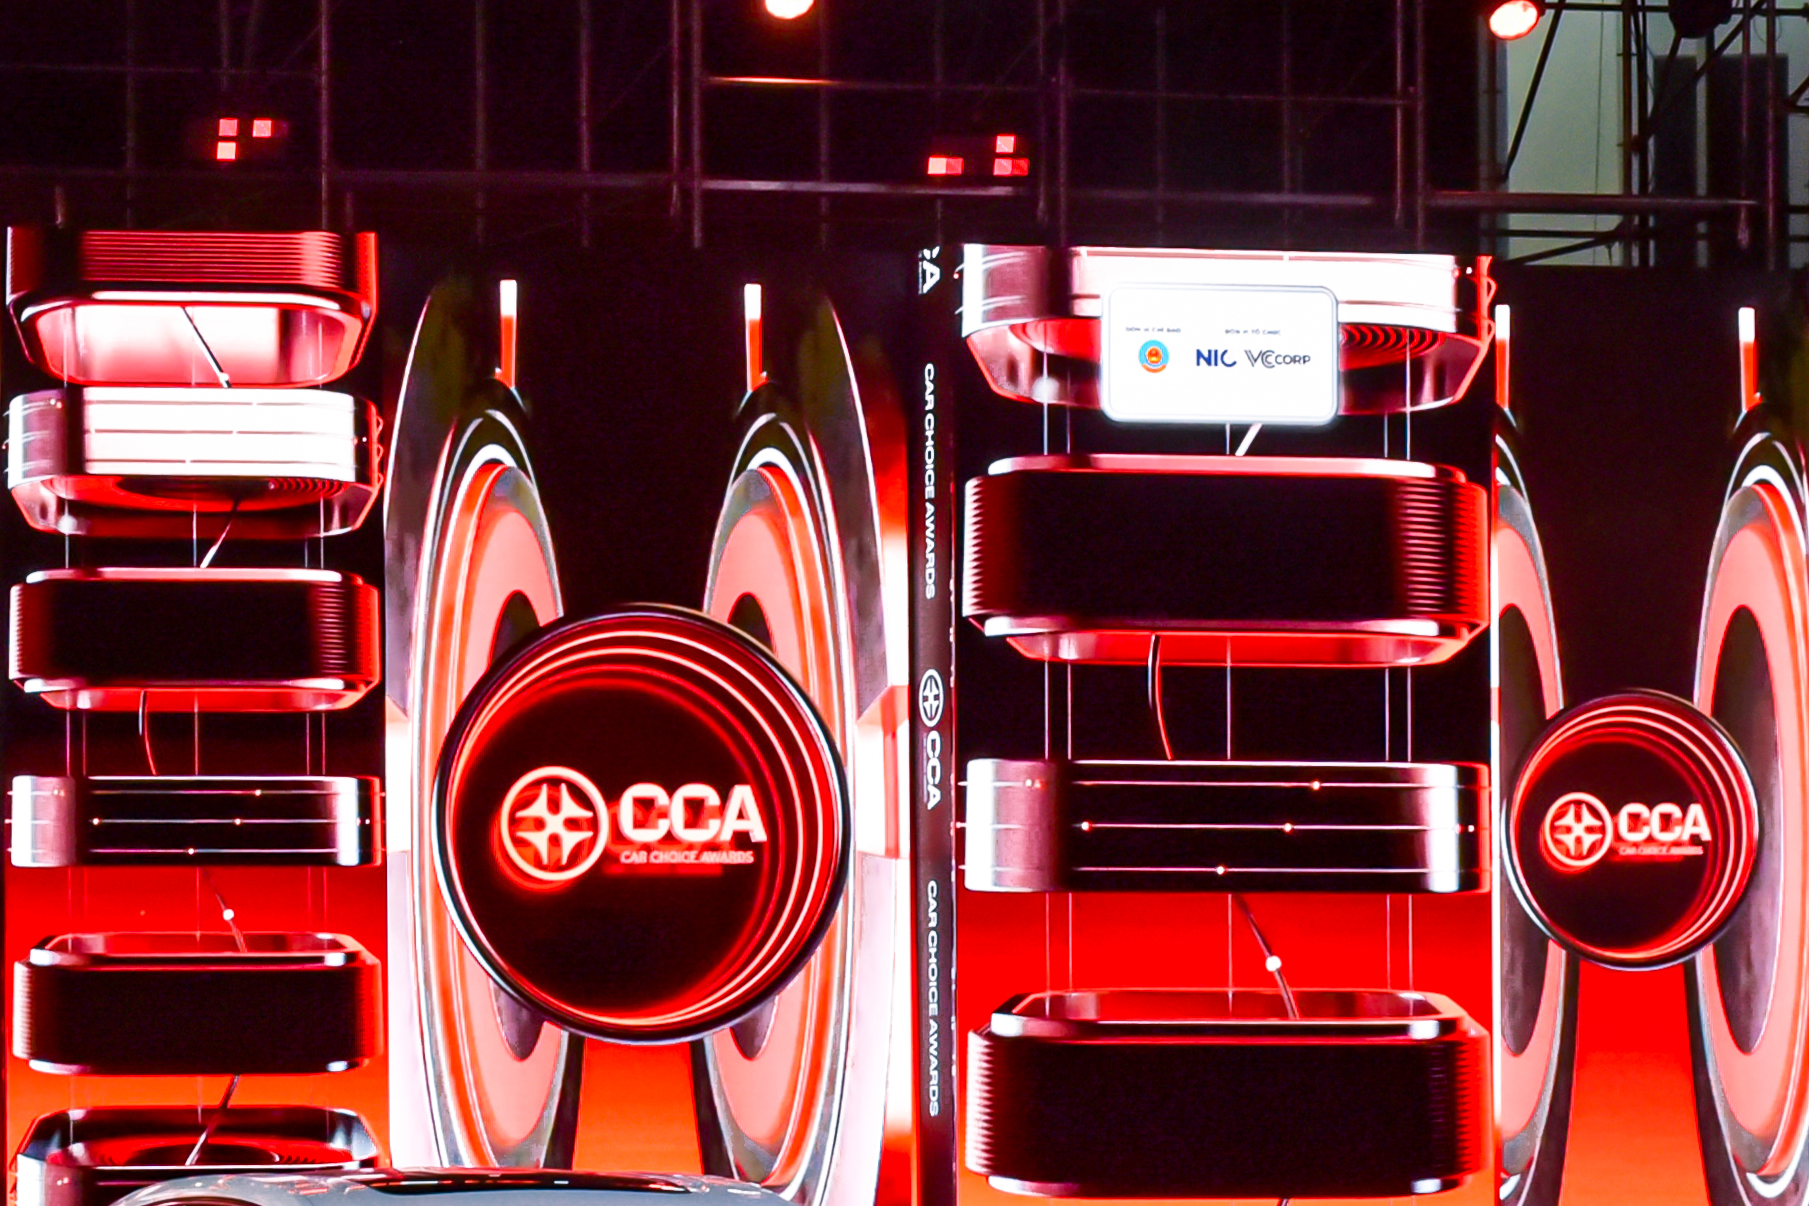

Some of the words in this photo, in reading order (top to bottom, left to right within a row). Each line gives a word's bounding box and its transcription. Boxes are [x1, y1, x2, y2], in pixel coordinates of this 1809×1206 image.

[924, 363, 936, 411] CAR
[1195, 348, 1238, 368] NIC
[924, 412, 936, 500] CHOICE
[925, 501, 937, 600] AWARDS
[925, 730, 942, 811] CCA
[619, 782, 768, 843] CCA
[1617, 802, 1712, 842] CCA
[620, 851, 648, 865] CAR
[649, 851, 698, 865] CHOICE
[699, 851, 755, 865] AWARDS
[927, 880, 939, 928] CAR
[927, 930, 939, 1017] CHOICE
[928, 1018, 940, 1117] AWARDS
